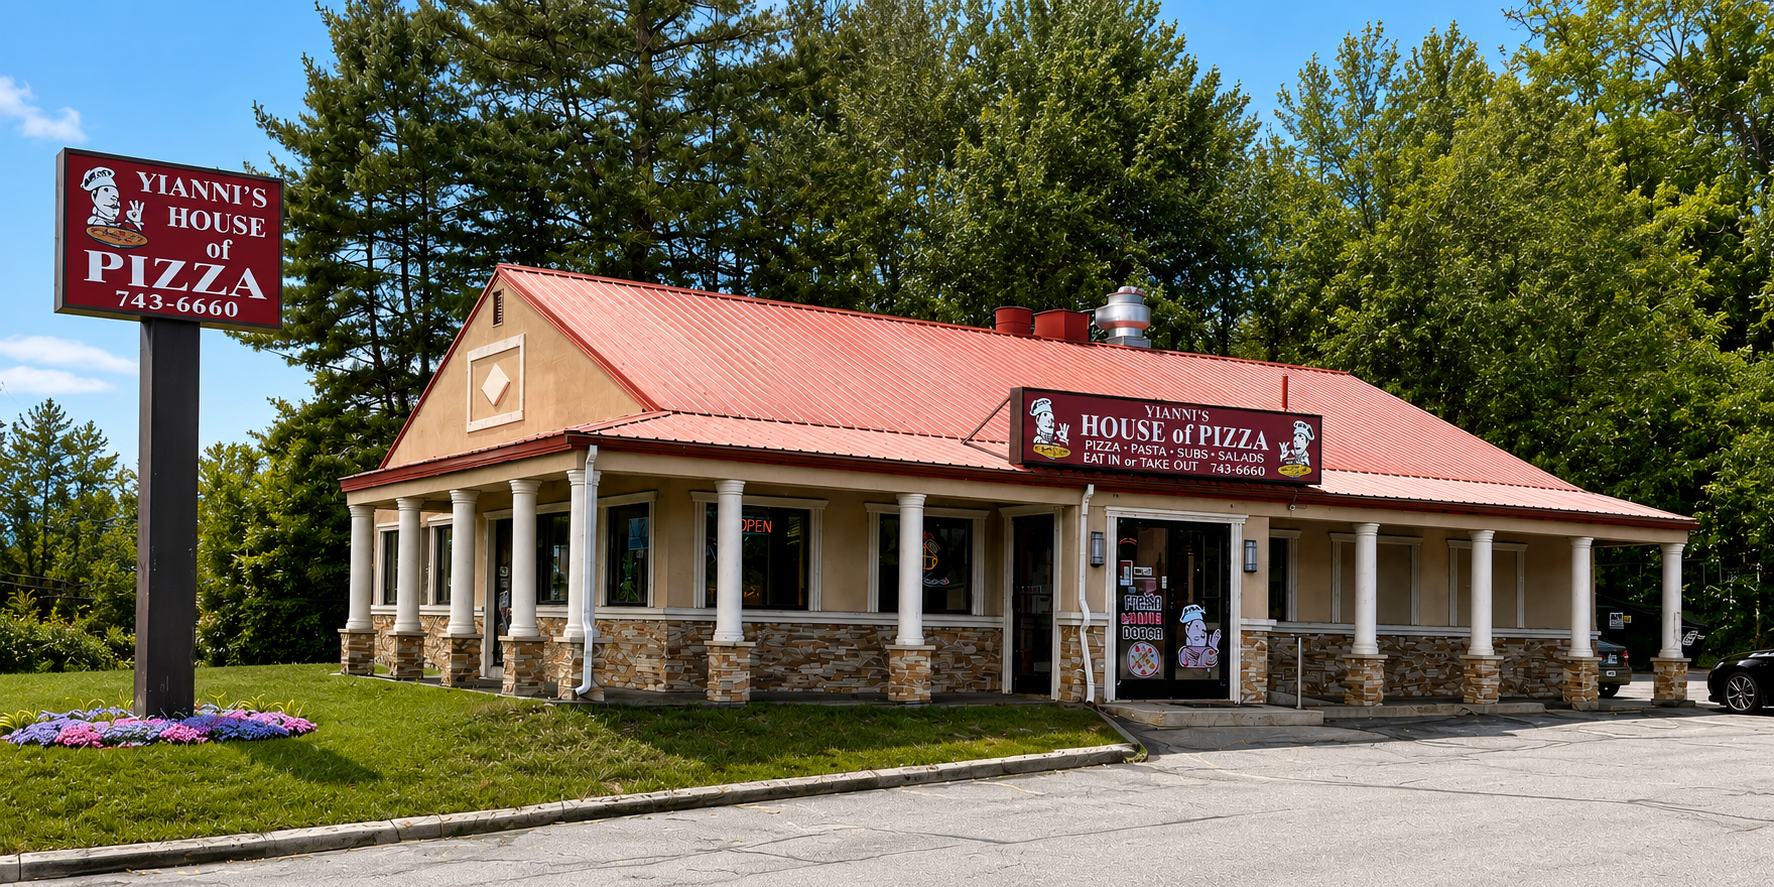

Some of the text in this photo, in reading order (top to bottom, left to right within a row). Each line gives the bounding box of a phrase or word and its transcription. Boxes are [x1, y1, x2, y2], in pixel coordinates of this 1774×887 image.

[136, 171, 267, 208] YIANNI'S
[167, 206, 266, 238] HOUSE
[206, 239, 233, 260] of
[83, 249, 267, 300] PIZZA
[115, 290, 238, 318] 743-6660
[1144, 405, 1209, 422] YIANNI'S
[1080, 414, 1269, 451] HOUSE of PIZZA
[1083, 452, 1265, 476] EAT IN or TAKE OUT 743-6660
[1085, 440, 1265, 463] PIZZA PASTA SUBS SALADS
